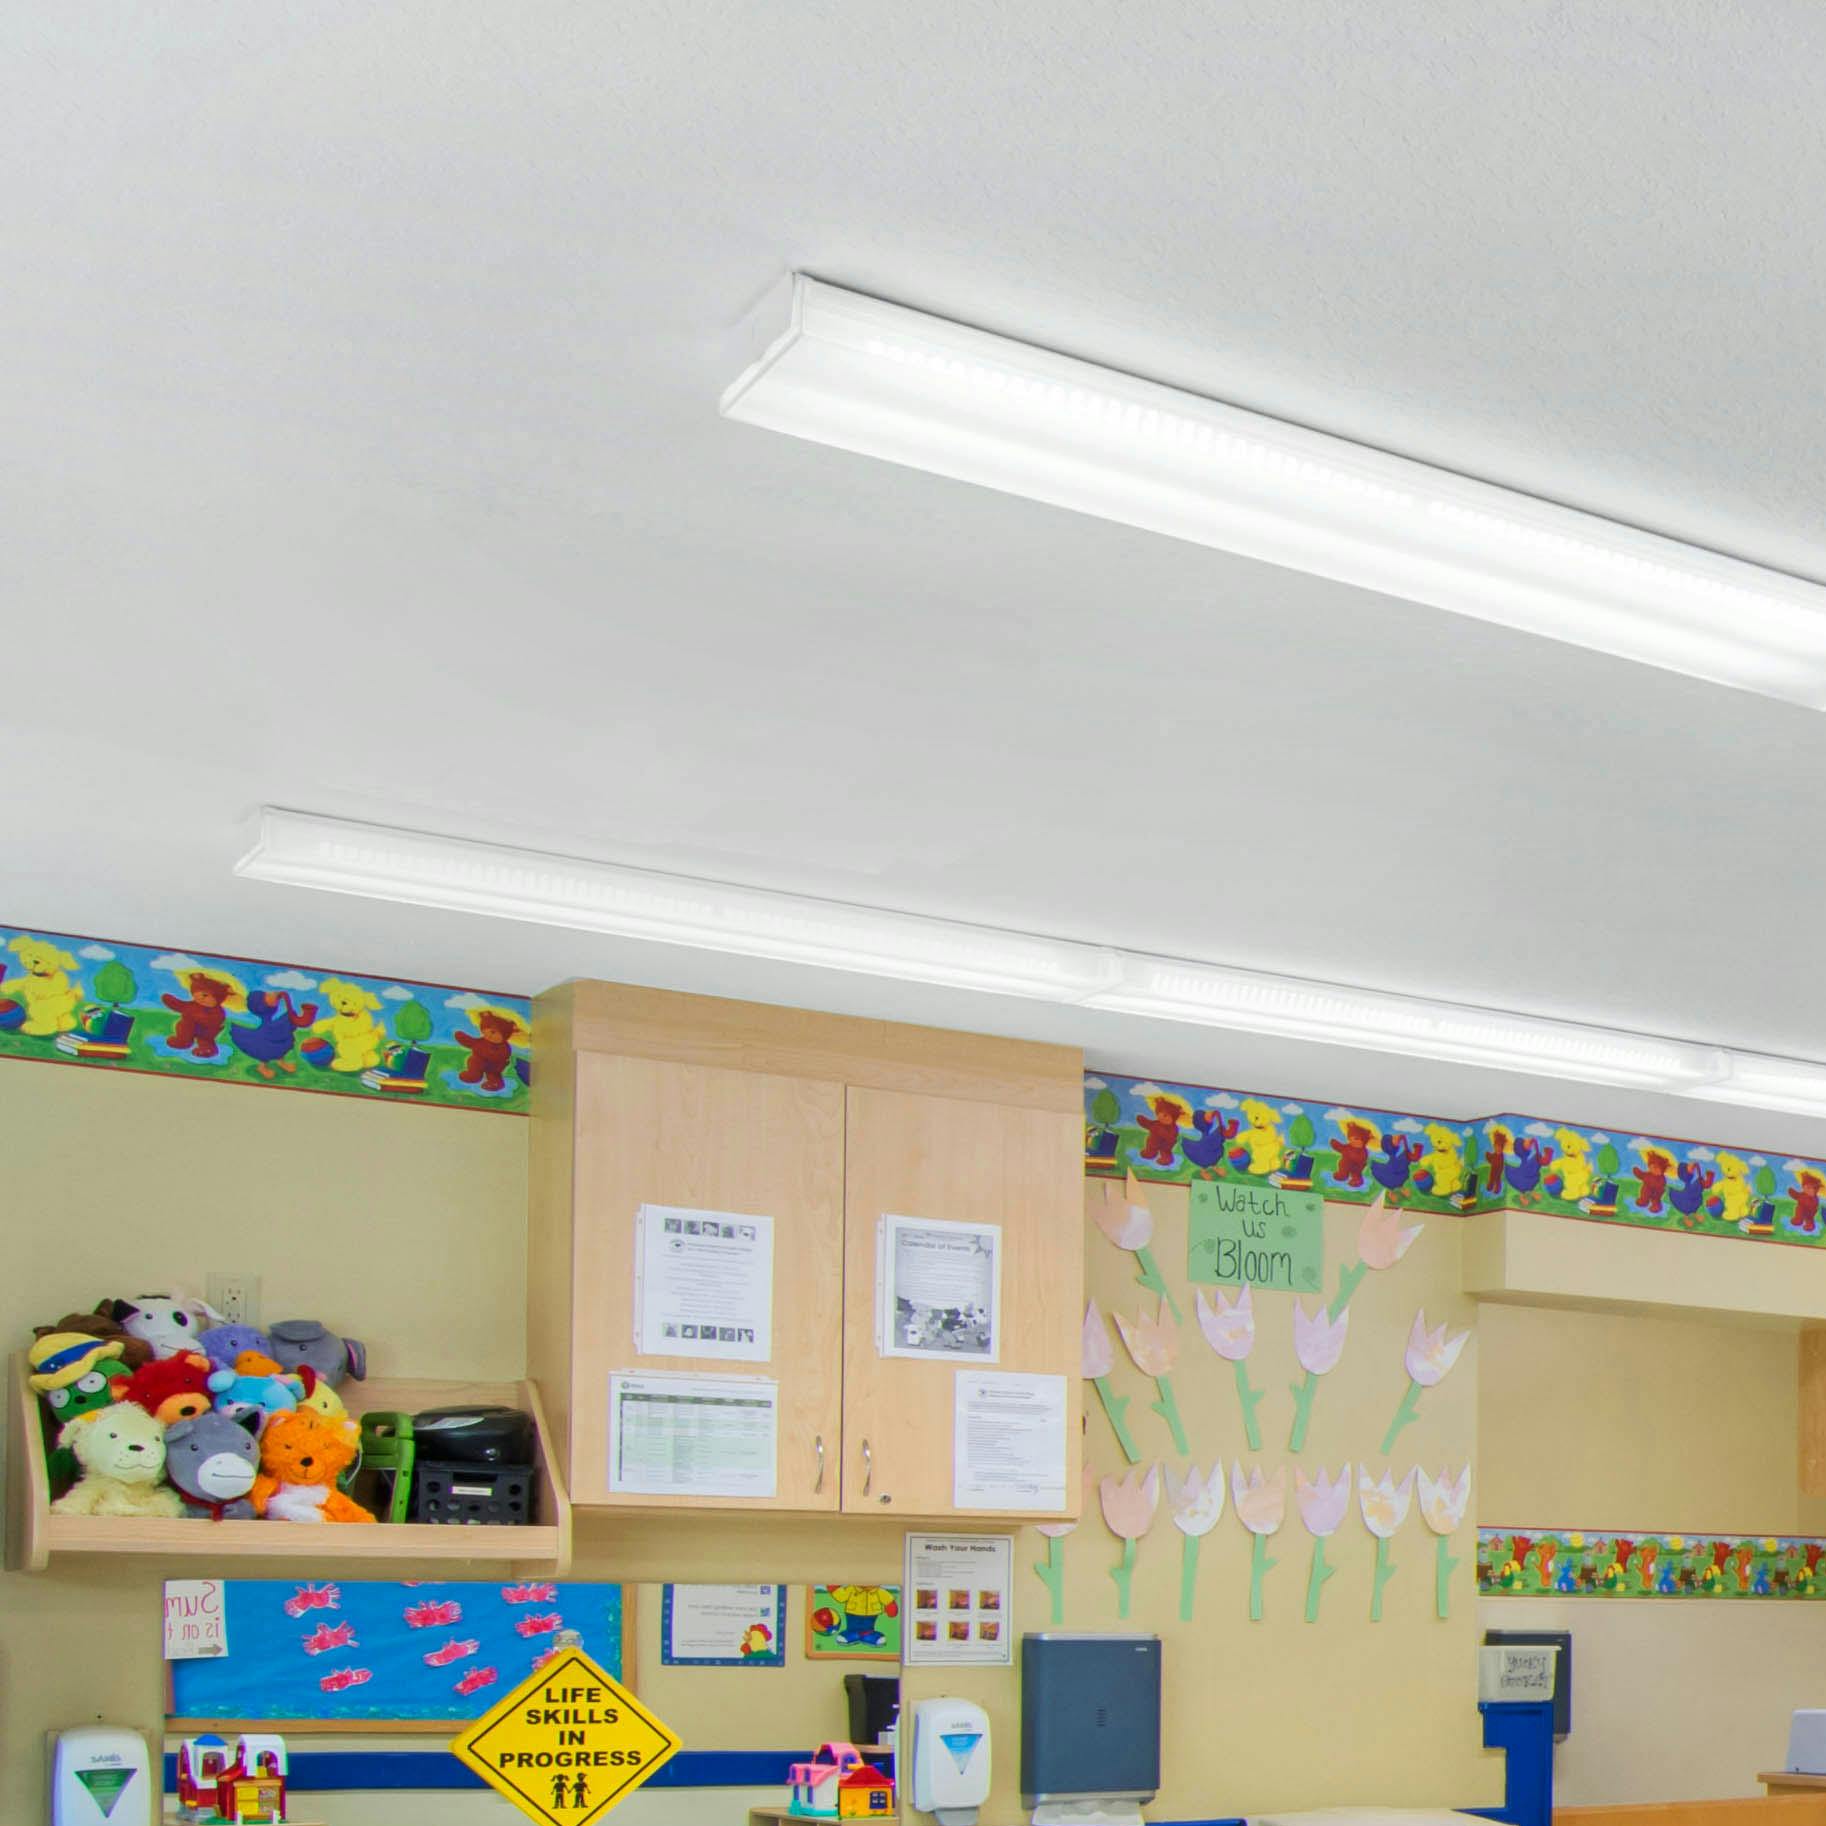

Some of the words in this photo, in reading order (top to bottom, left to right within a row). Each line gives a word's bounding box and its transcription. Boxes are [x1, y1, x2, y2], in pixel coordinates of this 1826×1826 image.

[1215, 1185, 1291, 1217] Watch
[1214, 1236, 1292, 1286] Bloom
[925, 1544, 947, 1552] Wash
[970, 1545, 996, 1553] Hands
[545, 1687, 602, 1704] LIFE
[526, 1708, 619, 1726] SKILLS
[559, 1729, 586, 1746] IN
[499, 1750, 642, 1769] PROGRESS
